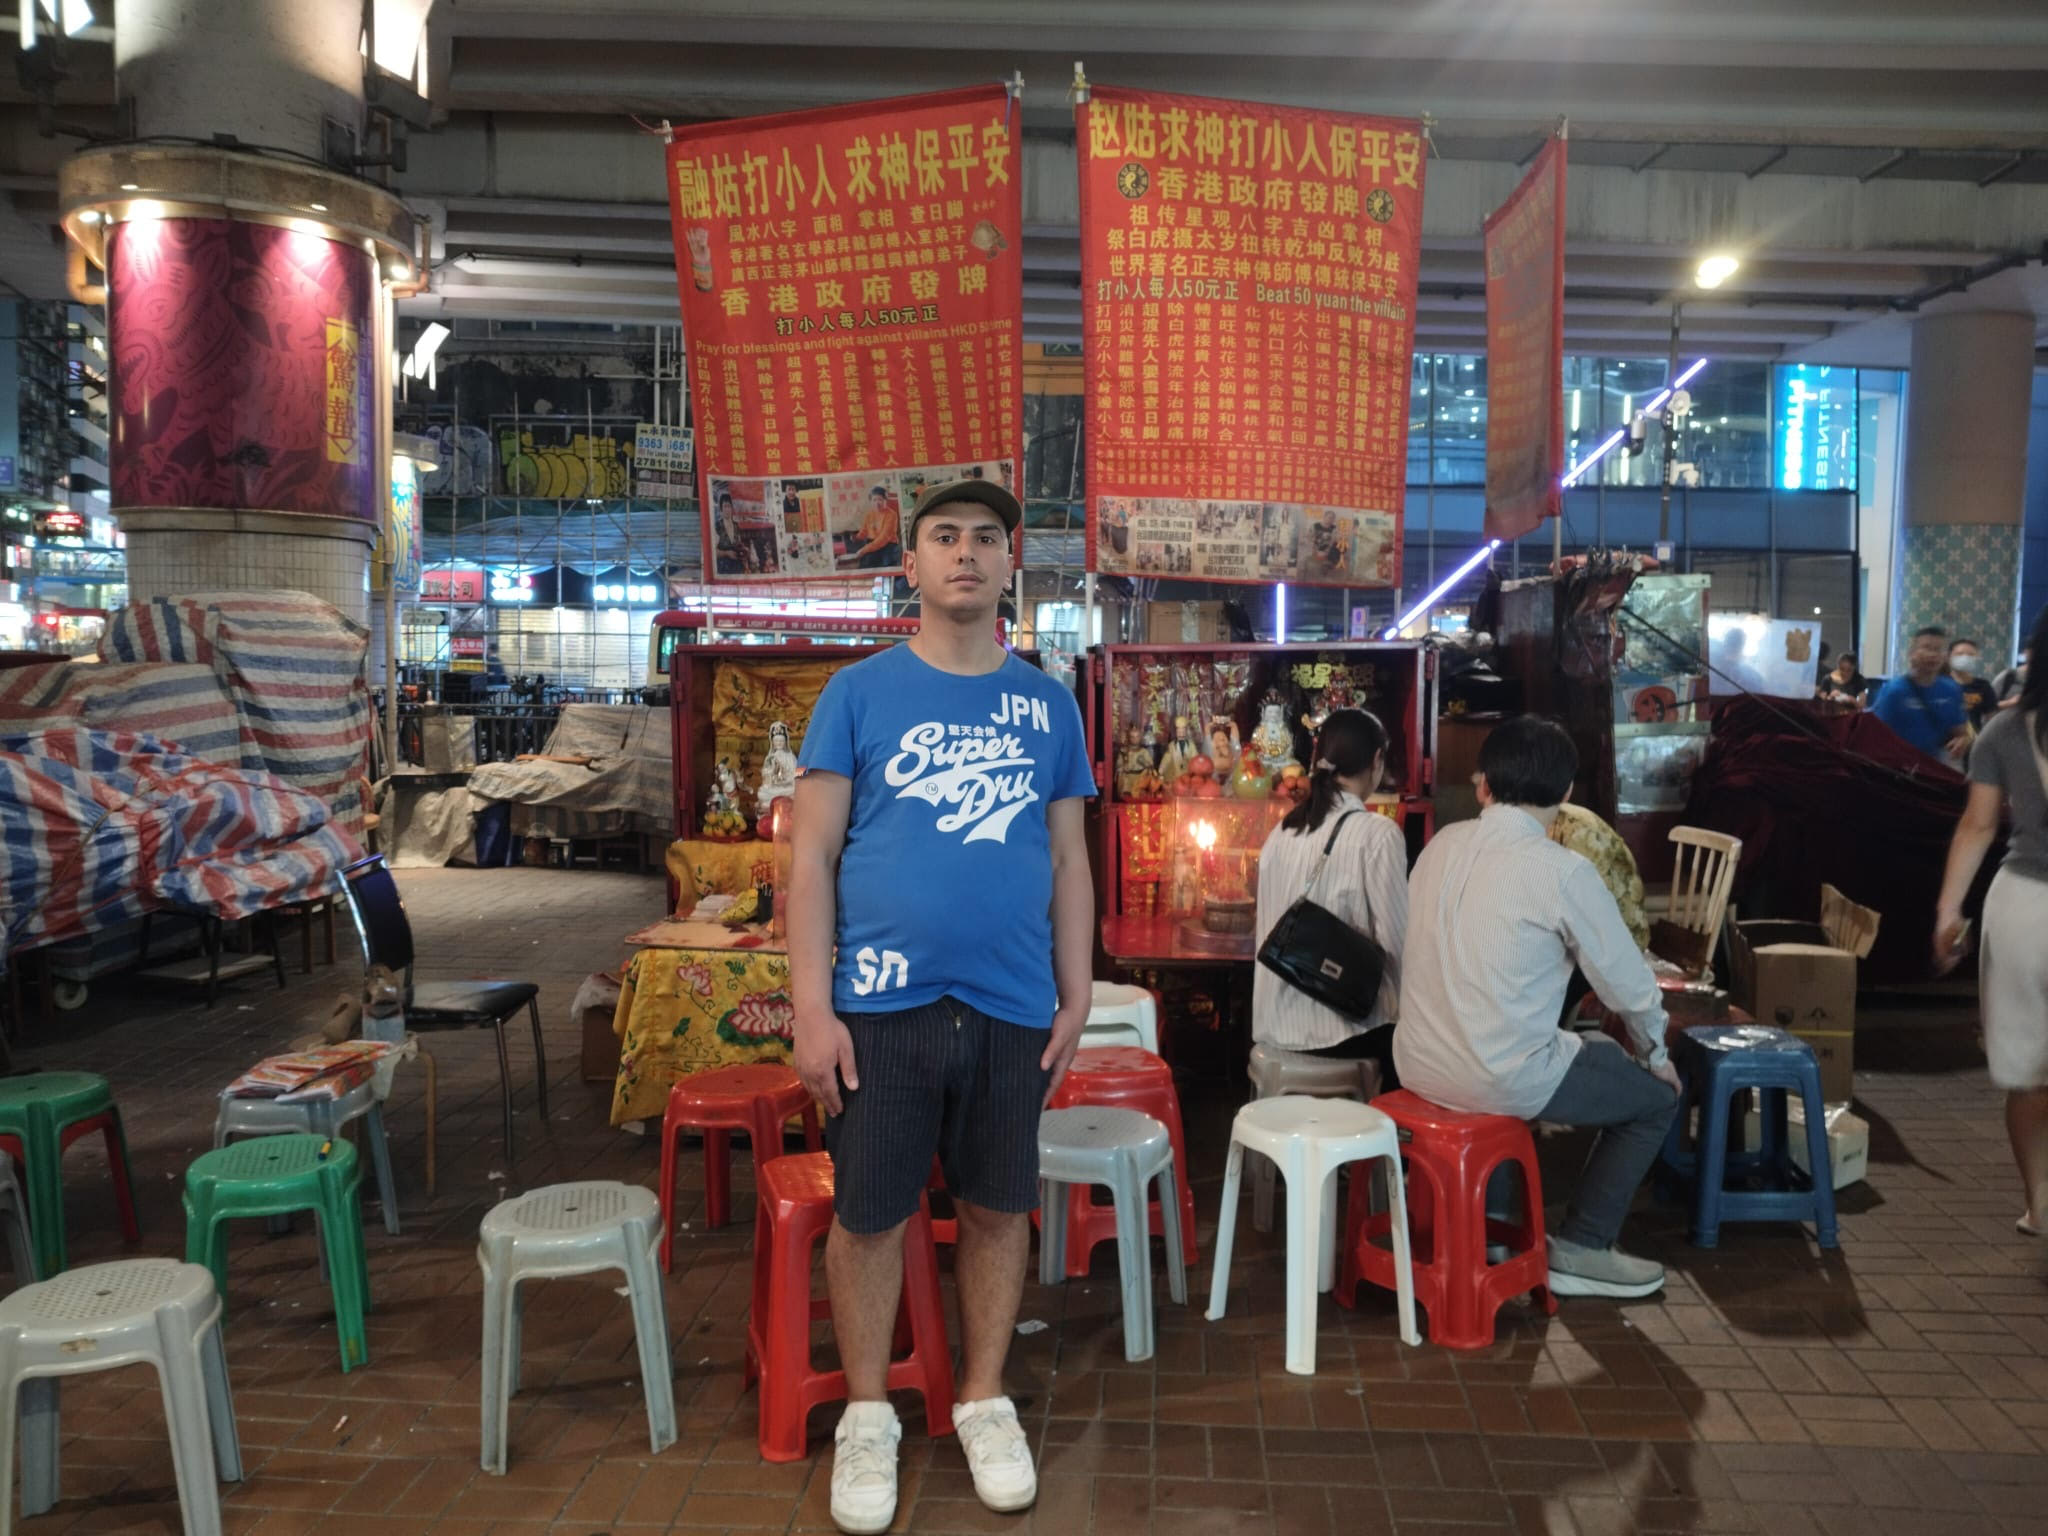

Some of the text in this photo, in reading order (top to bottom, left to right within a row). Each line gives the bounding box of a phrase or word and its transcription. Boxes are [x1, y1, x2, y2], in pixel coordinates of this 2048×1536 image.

[1089, 98, 1421, 189] 赵姑求神打小人保平安
[1157, 166, 1360, 218] 香港政府發牌
[728, 218, 797, 244] 風水八字
[719, 262, 988, 318] 香港政府發牌
[1097, 276, 1406, 321] 打小人每人50元正 Beat 50 yuan the villain
[696, 339, 720, 357] Pray
[722, 341, 740, 356] for
[742, 338, 802, 355] blessings
[803, 336, 825, 351] and
[827, 334, 855, 351] fight
[856, 331, 901, 349] against
[903, 327, 948, 342] villains
[951, 322, 978, 338] HKD
[776, 304, 939, 336] 打小人每人50元正
[990, 692, 1050, 733] JPN
[885, 722, 1024, 787] Super
